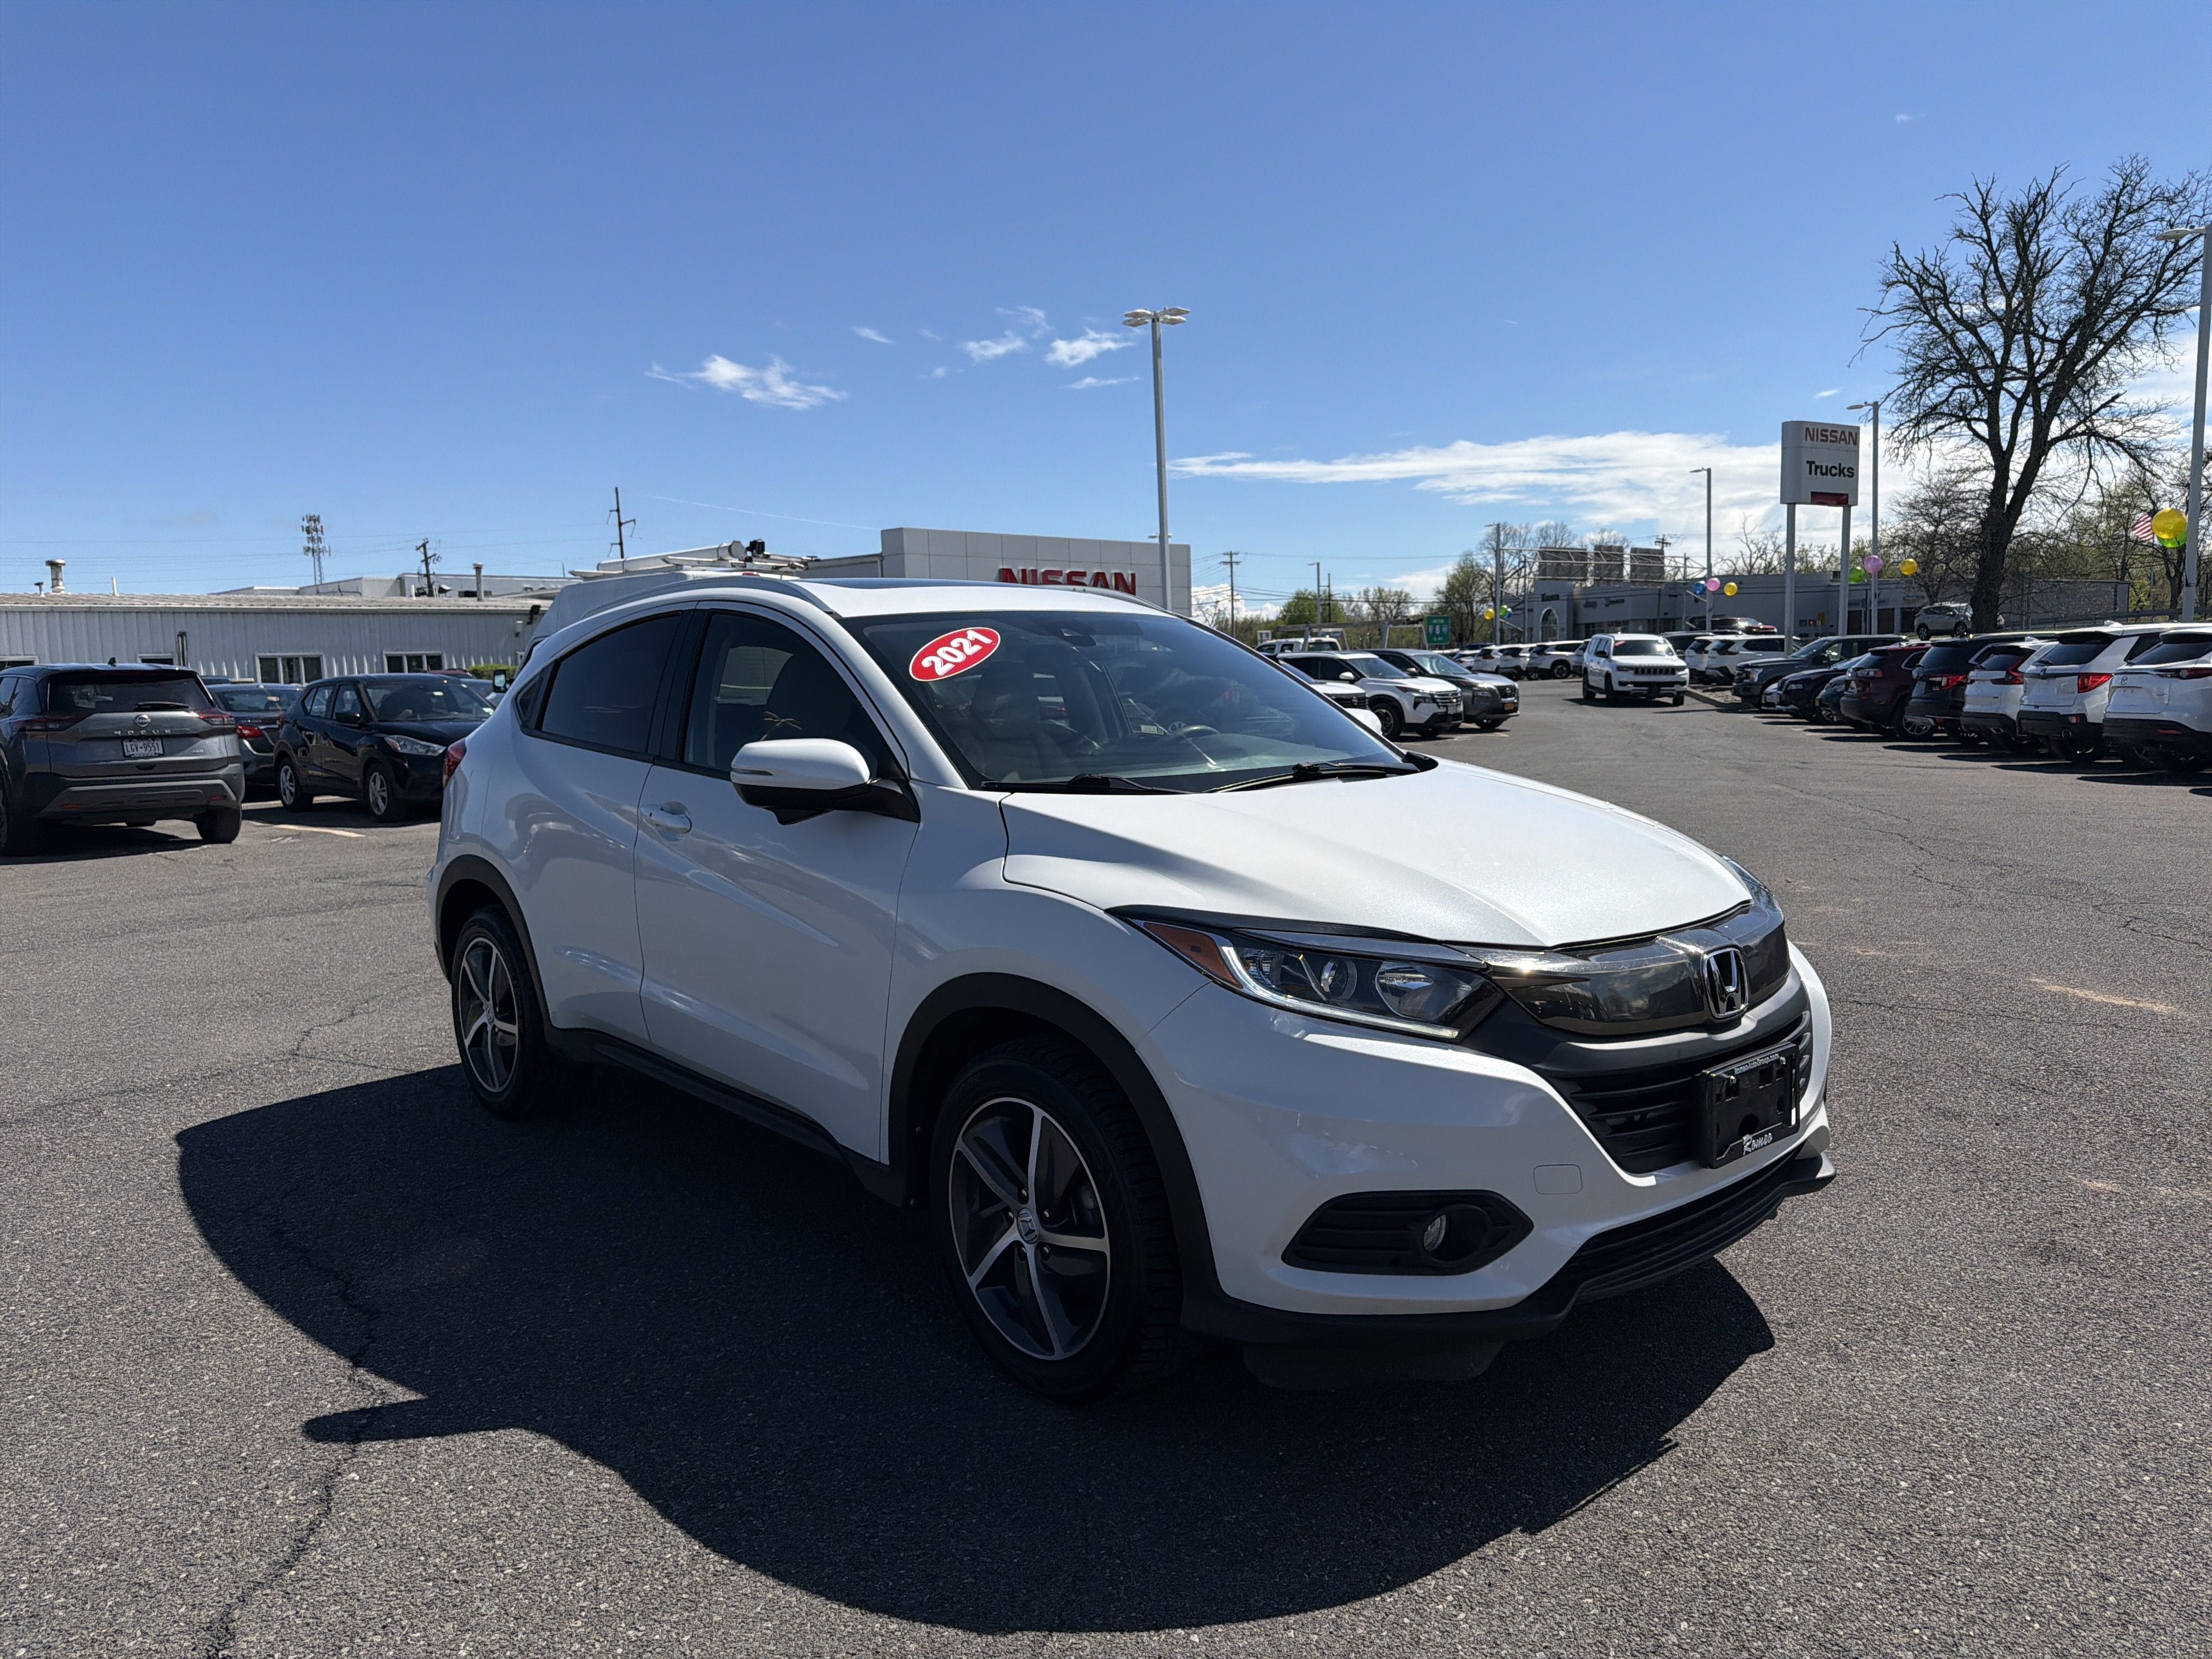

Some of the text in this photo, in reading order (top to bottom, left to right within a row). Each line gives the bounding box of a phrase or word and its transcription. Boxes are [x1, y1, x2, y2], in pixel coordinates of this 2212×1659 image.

[1805, 427, 1858, 445] NISSAN
[1806, 460, 1855, 478] Trucks
[1000, 567, 1136, 596] NISSAN
[921, 629, 993, 676] 2021
[1742, 1133, 1773, 1156] Romeo
